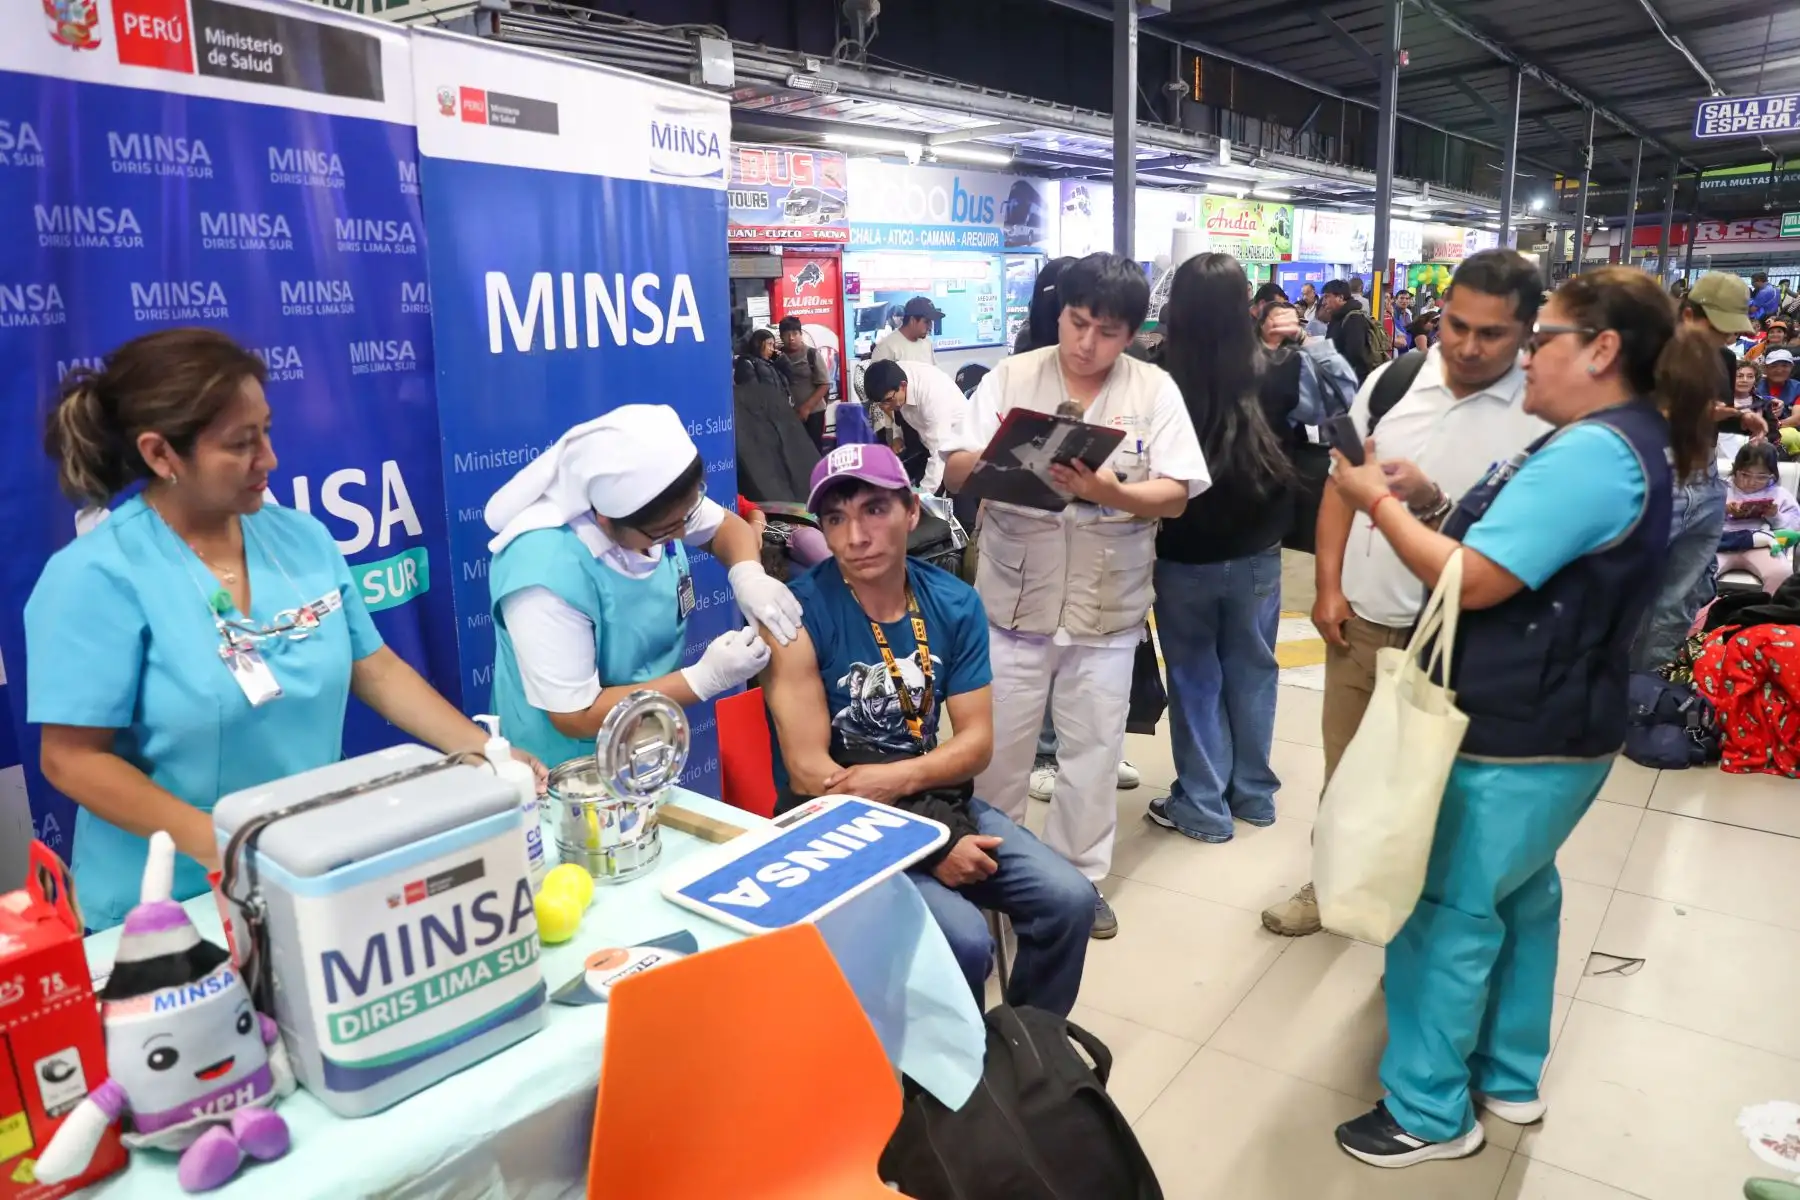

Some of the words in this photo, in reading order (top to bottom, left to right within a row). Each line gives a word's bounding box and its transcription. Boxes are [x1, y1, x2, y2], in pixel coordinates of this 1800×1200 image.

[122, 11, 183, 43] PERÚ
[204, 26, 283, 56] Ministerio
[207, 50, 228, 68] de
[230, 51, 274, 74] Salud
[1705, 101, 1759, 119] SALA
[1766, 97, 1798, 114] DE
[1705, 113, 1790, 133] ESPERA
[107, 131, 212, 165] MINSA
[650, 120, 721, 160] MINSA
[13, 152, 45, 167] SUR
[111, 160, 151, 174] DIRIS
[155, 164, 184, 176] LIMA
[187, 166, 214, 179] SUR
[268, 147, 345, 177] MINSA
[740, 148, 814, 187] BUS
[270, 173, 301, 184] DIRIS
[1729, 176, 1770, 186] MULTAS
[728, 191, 768, 209] TOURS
[34, 204, 142, 234] MINSA
[200, 212, 292, 238] MINSA
[335, 217, 416, 243] MINSA
[1207, 208, 1256, 230] Andia
[39, 234, 71, 247] DIRIS
[74, 235, 109, 248] LIMA
[113, 236, 144, 248] SUR
[203, 237, 237, 250] DIRIS
[240, 239, 266, 250] LIMA
[269, 239, 293, 251] SUR
[363, 242, 391, 254] LIMA
[394, 243, 417, 255] SUR
[850, 228, 881, 244] CHALA
[888, 229, 914, 245] ATICO
[920, 231, 955, 246] CAMANA
[961, 232, 1000, 247] AREQUIPA
[0, 284, 65, 312] NSA
[130, 281, 228, 308] MINSA
[280, 280, 354, 303] MINSA
[783, 296, 820, 307] TAURO
[43, 312, 67, 325] SUR
[134, 308, 170, 321] DIRIS
[172, 308, 200, 320] LIMA
[203, 307, 229, 319] SUR
[282, 304, 313, 316] DIRIS
[316, 303, 340, 315] LIMA
[485, 271, 705, 354] MINSA
[350, 340, 416, 364] MINSA
[282, 369, 304, 380] SUR
[370, 363, 393, 373] LIMA
[394, 361, 416, 372] SUR
[688, 419, 702, 436] de
[705, 414, 733, 434] Salud
[454, 444, 540, 473] Ministerio
[706, 461, 716, 473] de
[717, 458, 734, 472] Salud
[363, 557, 419, 604] SUR
[696, 595, 710, 611] de
[713, 586, 735, 606] Salu
[704, 757, 718, 773] de
[709, 807, 909, 908] MINSA
[320, 877, 537, 1005] MINSA
[154, 972, 235, 1012] MINSA
[337, 993, 417, 1043] DIRIS
[424, 960, 490, 1007] LIMA
[499, 936, 541, 980] SUR
